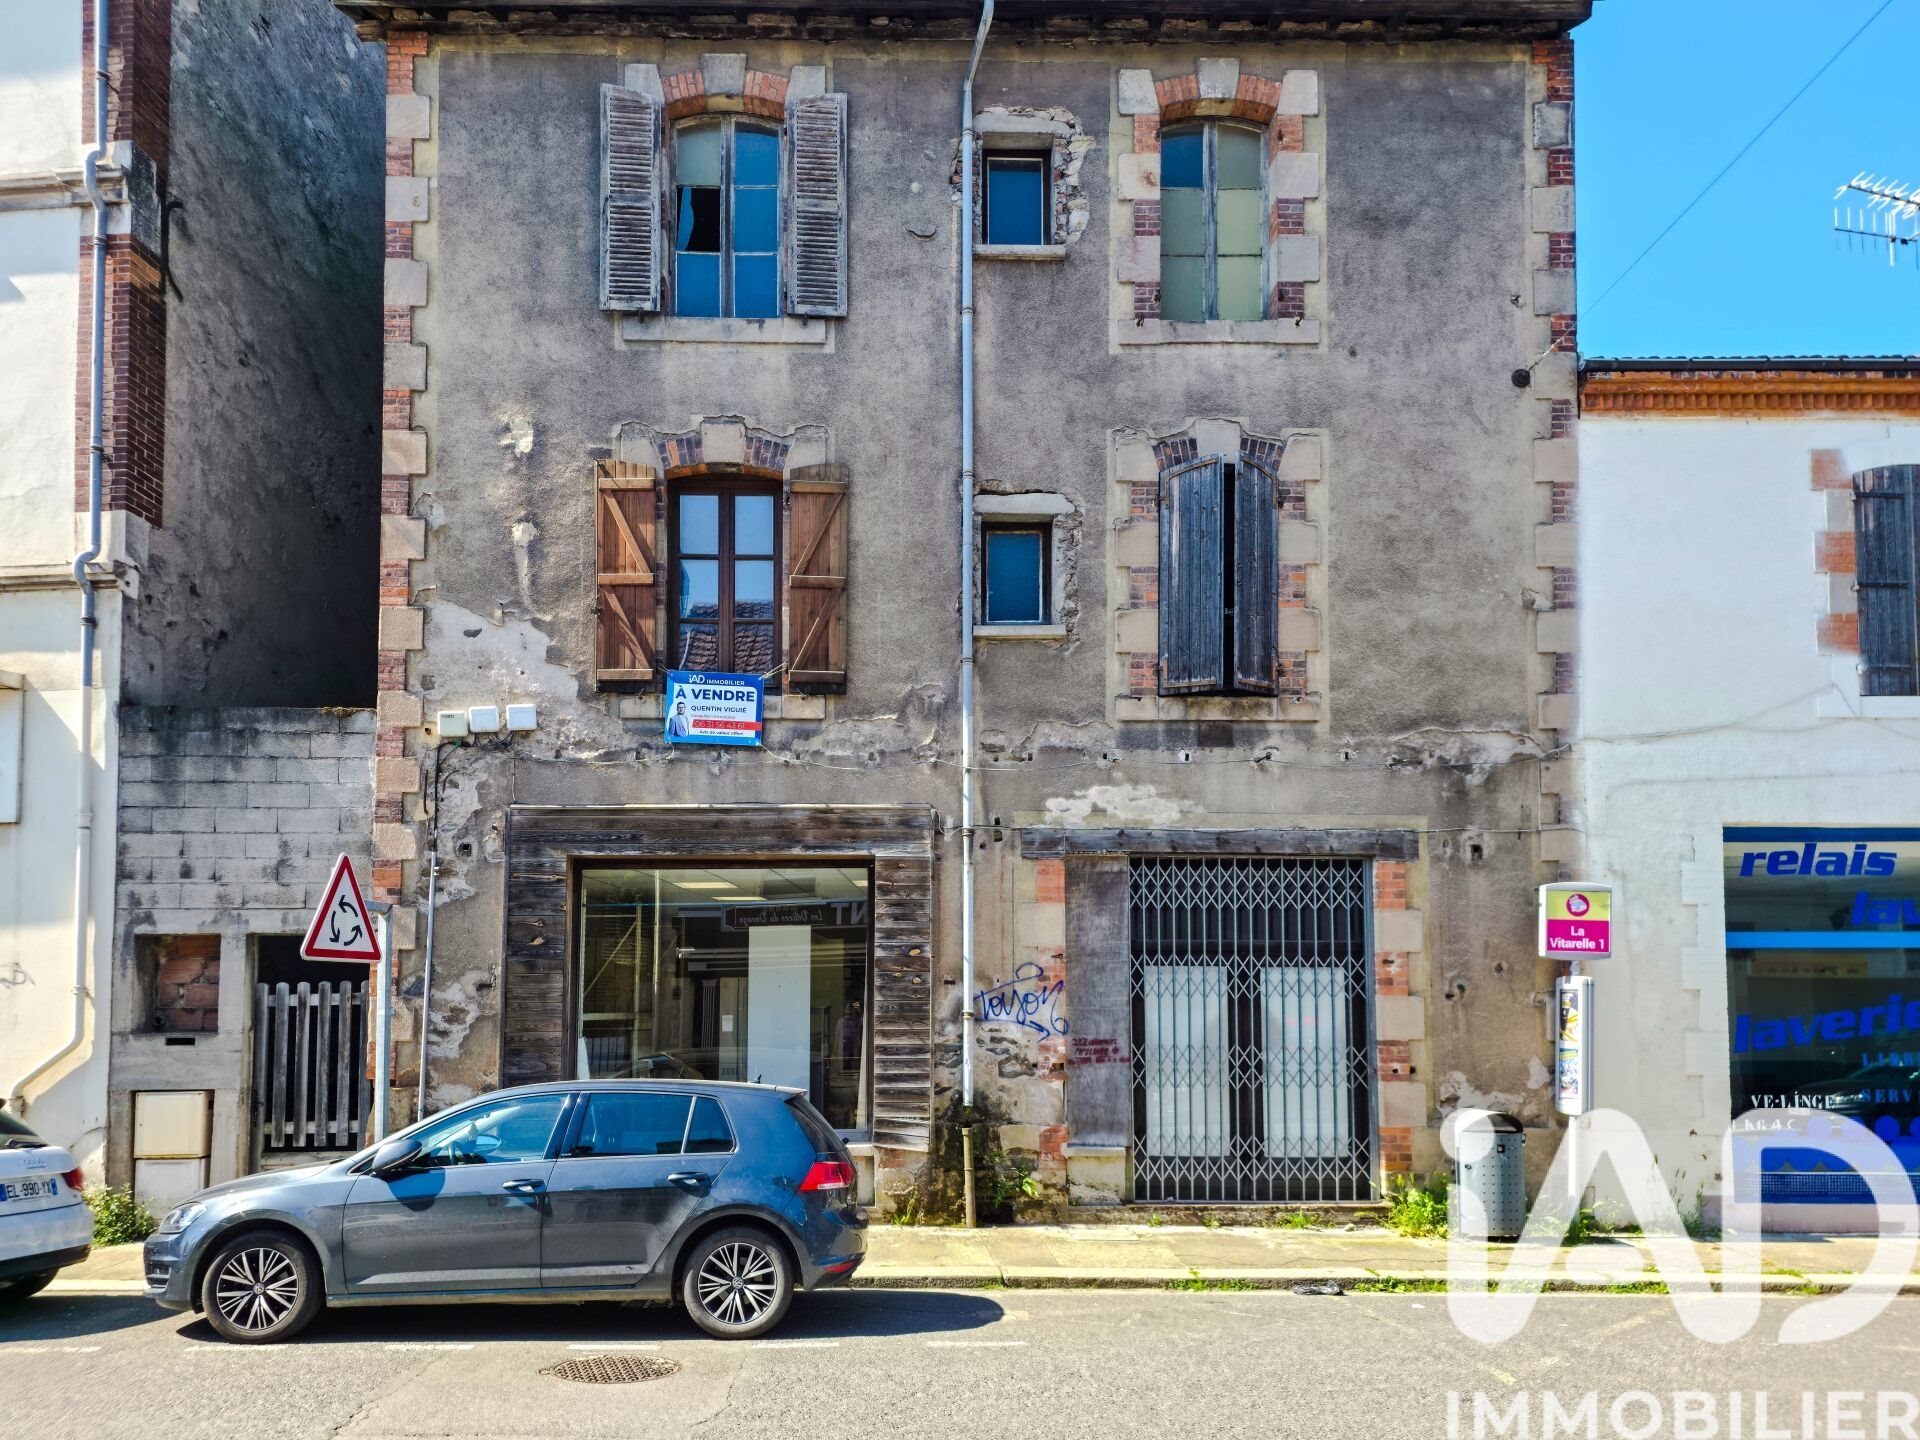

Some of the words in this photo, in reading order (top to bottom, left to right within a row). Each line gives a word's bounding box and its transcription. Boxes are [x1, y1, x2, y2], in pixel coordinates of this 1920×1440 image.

[691, 688, 755, 702] VENDRE
[1739, 842, 1898, 877] relais
[1570, 925, 1585, 937] La
[1549, 936, 1596, 949] Vitarelle
[1598, 938, 1605, 950] 1
[1860, 1088, 1920, 1104] SERV
